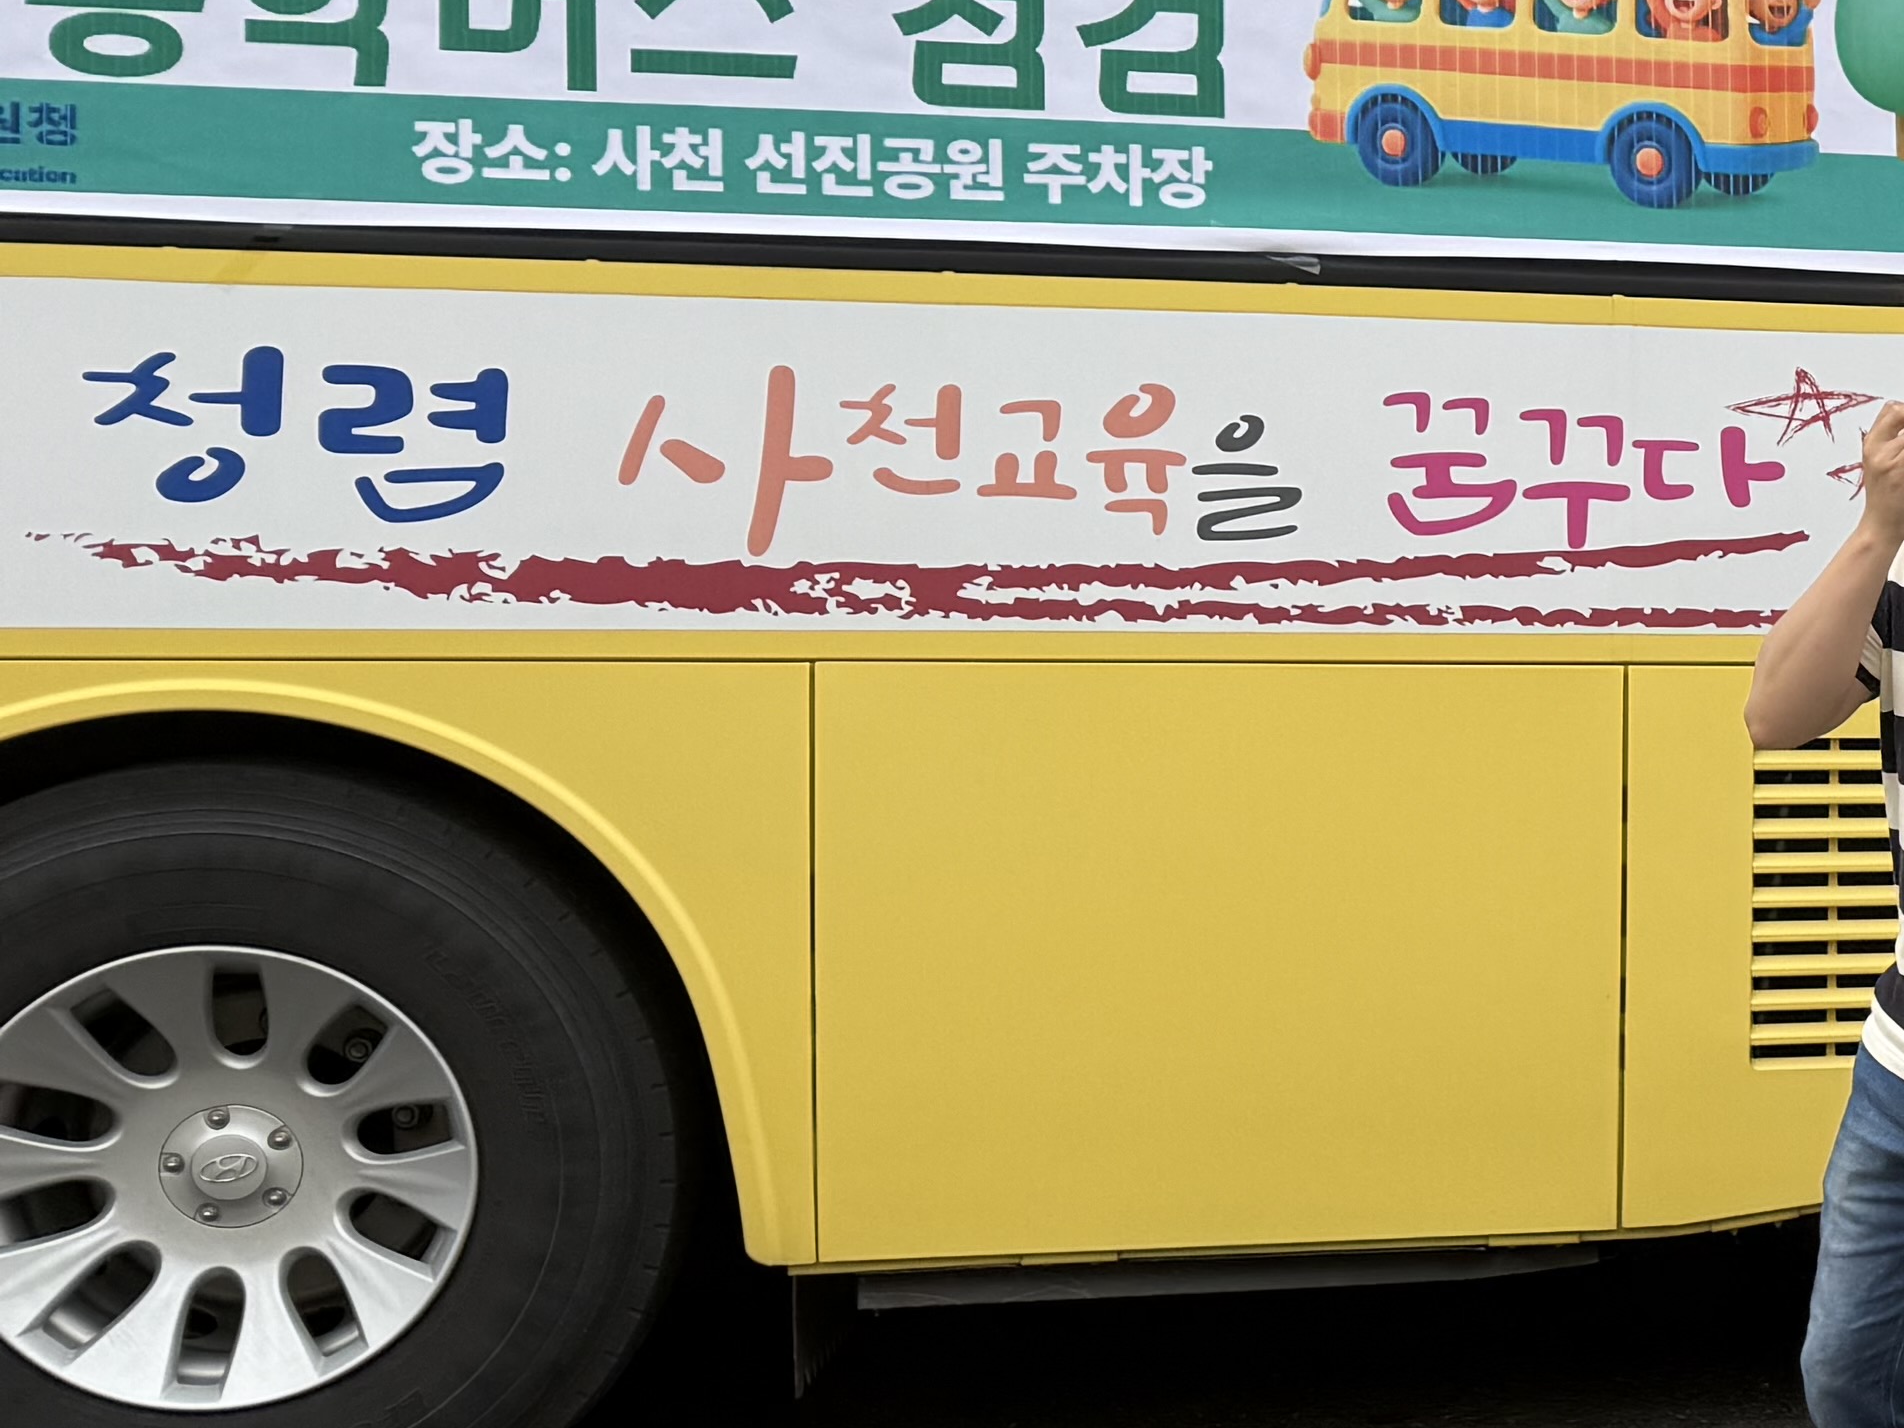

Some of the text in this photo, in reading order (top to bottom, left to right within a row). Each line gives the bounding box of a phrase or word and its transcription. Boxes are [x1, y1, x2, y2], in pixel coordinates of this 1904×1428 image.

[411, 118, 1214, 211] 장소: 사천 선진공원 주차장
[82, 345, 1786, 557] 청렴 사천교육을 꿈꾸다
